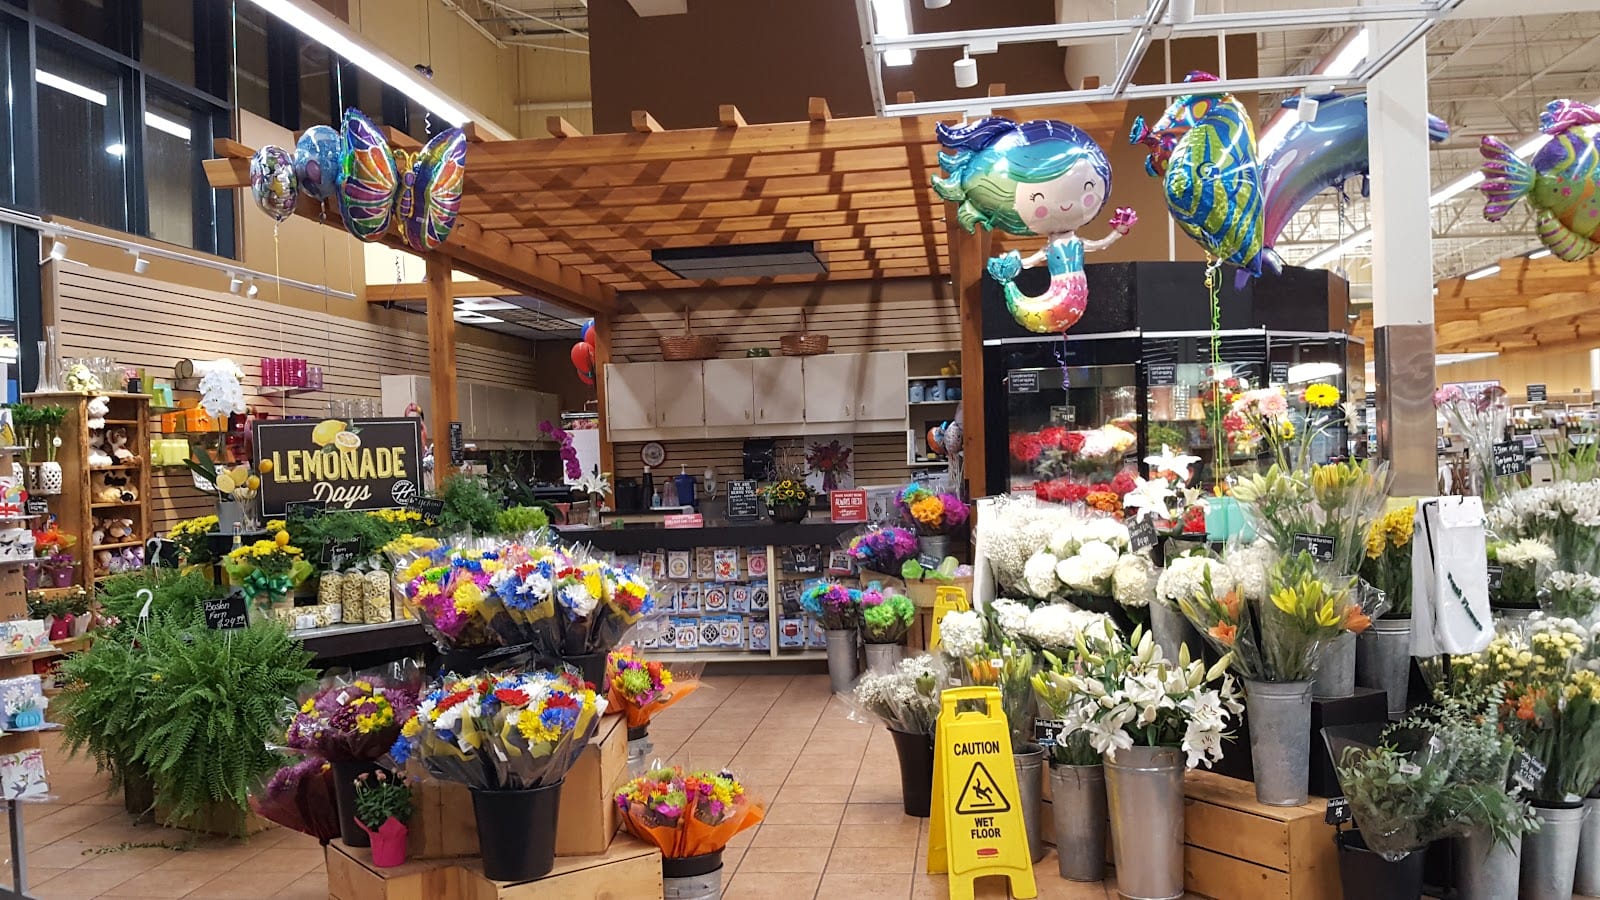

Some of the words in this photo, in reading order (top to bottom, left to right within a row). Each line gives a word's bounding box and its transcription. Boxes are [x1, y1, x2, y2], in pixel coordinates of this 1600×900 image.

[272, 446, 408, 484] LEMONADE
[308, 481, 372, 509] Days
[1308, 542, 1319, 556] $5
[702, 557, 712, 571] 2
[708, 595, 720, 604] 16
[679, 631, 694, 642] 70
[722, 627, 738, 638] 90
[953, 740, 1000, 756] CAUTION
[974, 816, 995, 828] WET
[970, 827, 1002, 840] FLOOR
